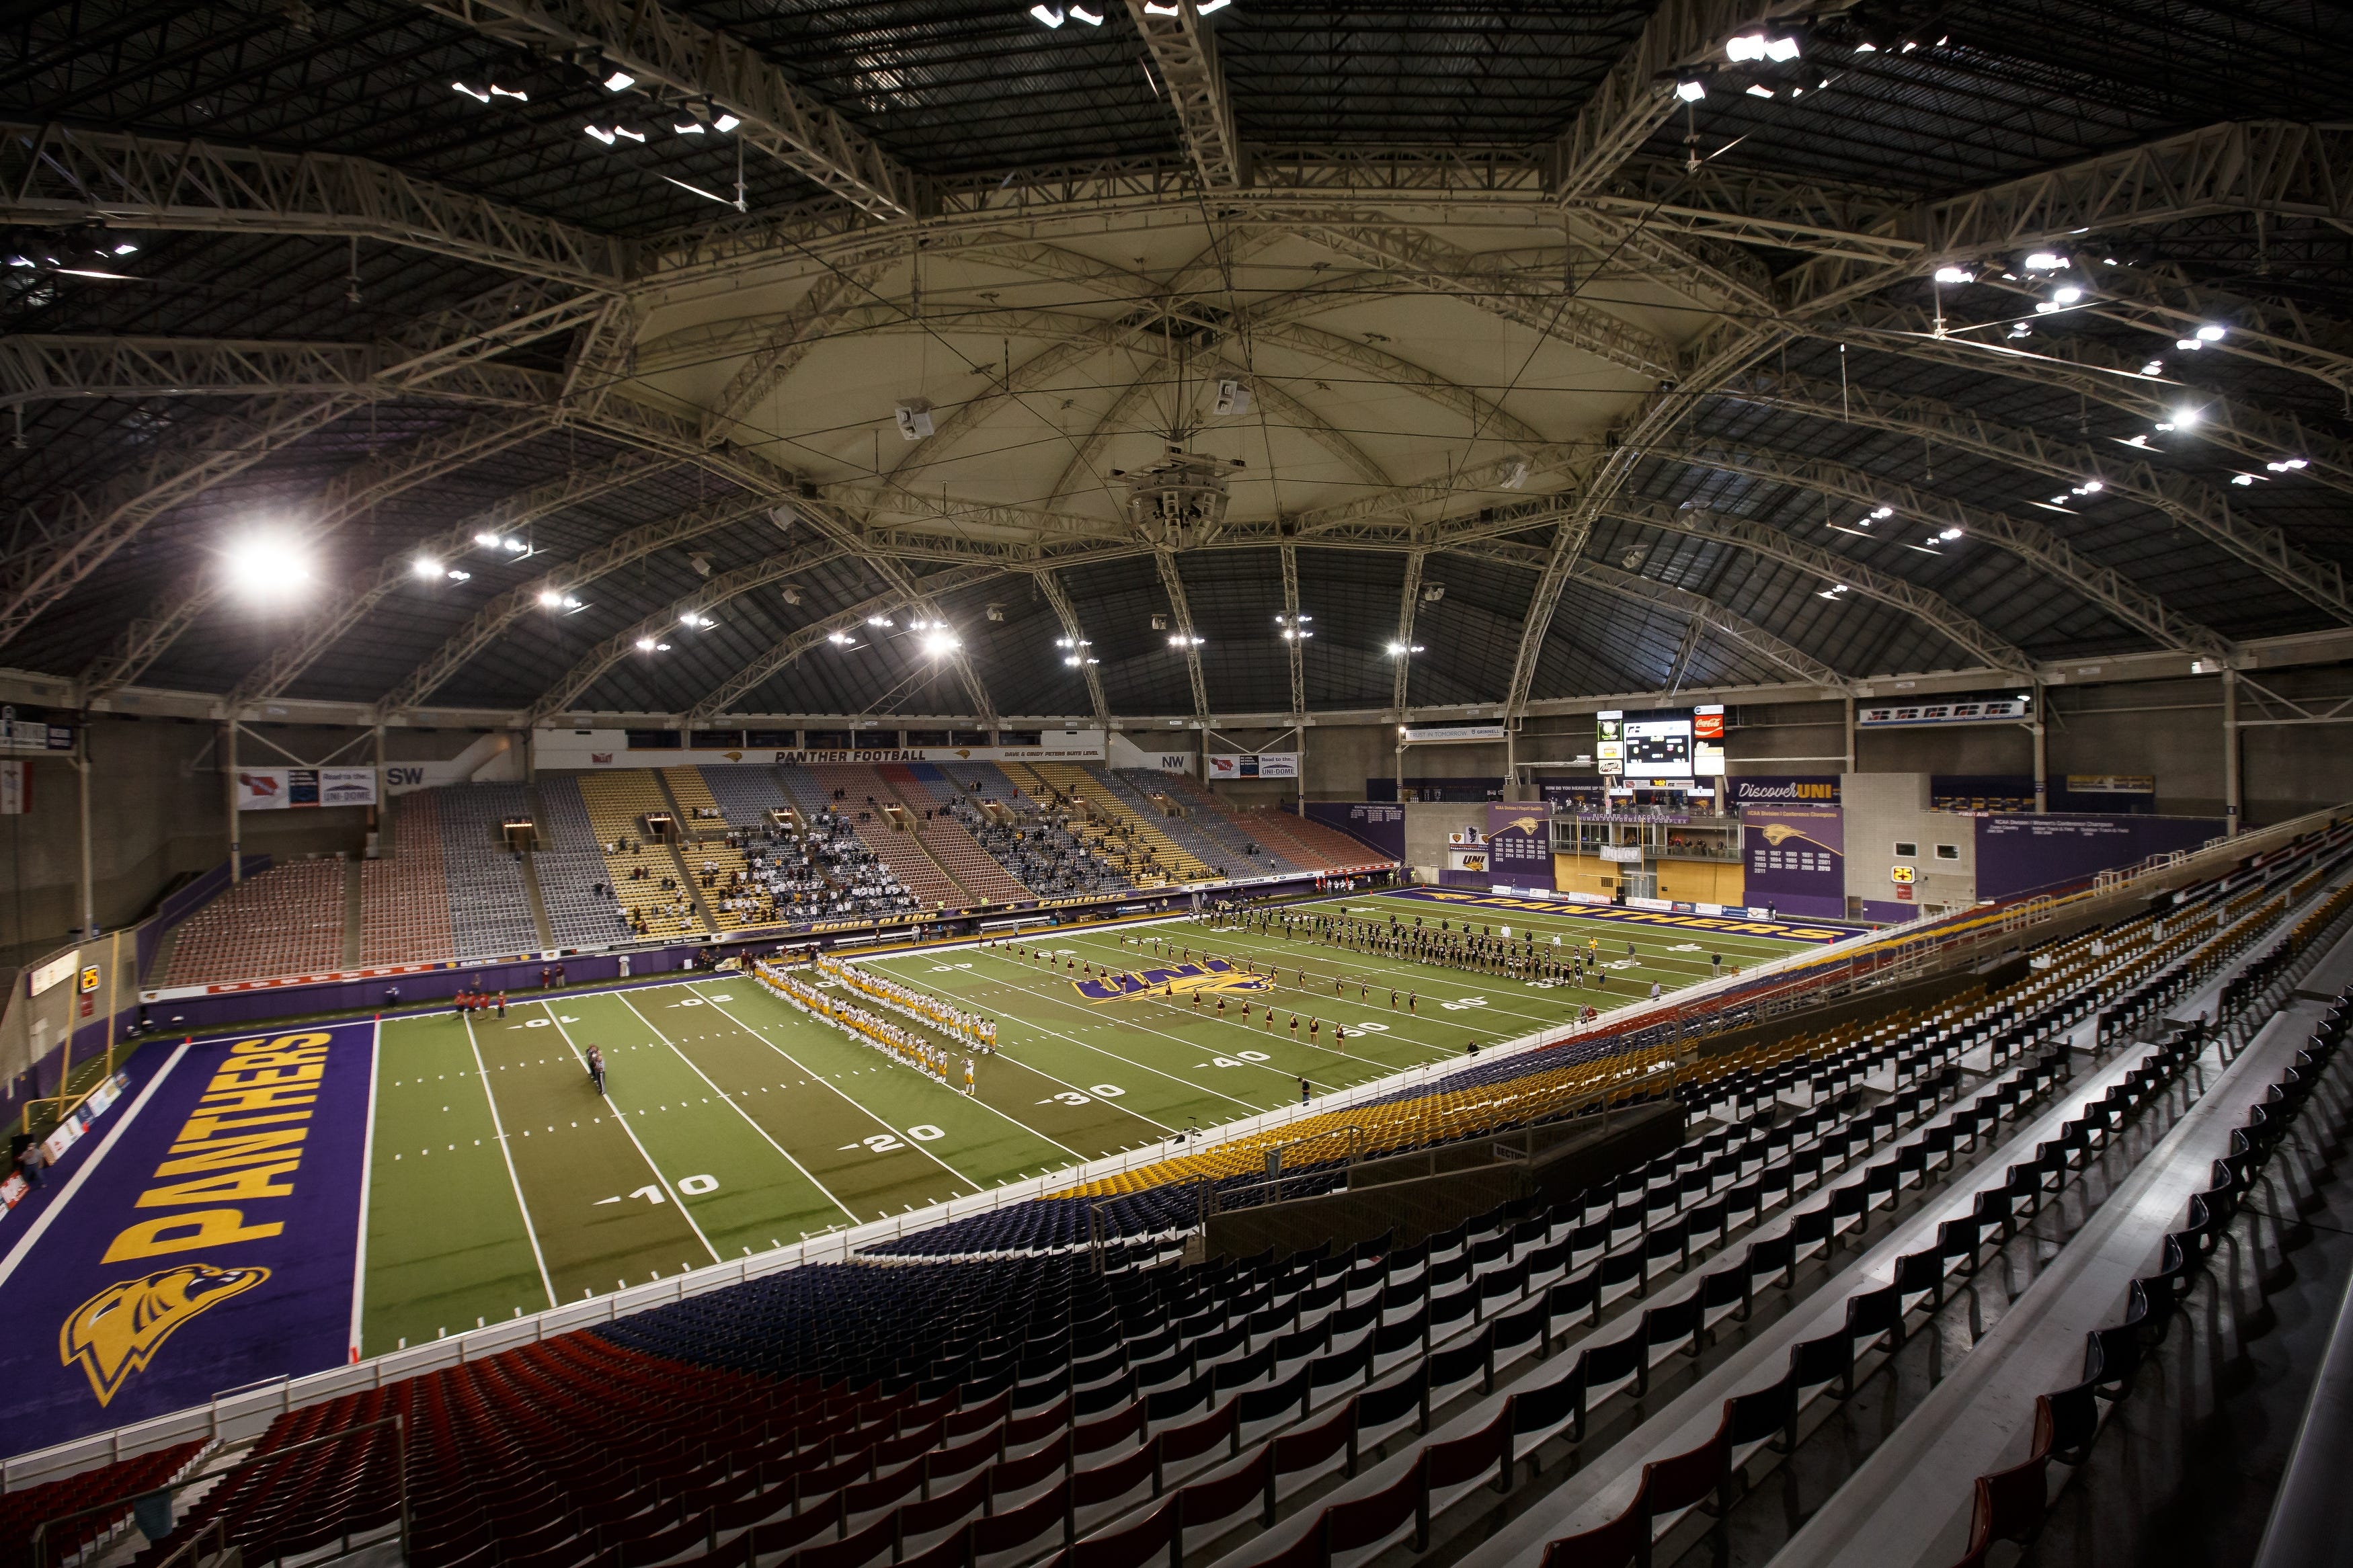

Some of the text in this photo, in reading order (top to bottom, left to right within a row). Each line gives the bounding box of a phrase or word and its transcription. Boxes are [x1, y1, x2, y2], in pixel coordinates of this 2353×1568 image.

[1696, 718, 1721, 727] Coca-Cola
[775, 750, 926, 763] PANTHER FOOTBALL
[1162, 755, 1185, 768] NW
[387, 768, 424, 786] SW
[1739, 782, 1832, 798] Discover UNI
[1463, 855, 1485, 864] UNI
[1894, 868, 1912, 881] 25
[811, 893, 1127, 932] Home of the Panthers
[1467, 898, 1845, 940] PANTHERS
[932, 962, 973, 973] 40
[1071, 959, 1239, 999] UNI
[680, 994, 734, 1007] 20
[1440, 997, 1488, 1010] 40
[525, 1016, 581, 1028] 10
[1332, 1022, 1390, 1038] 50
[1210, 1050, 1271, 1069] 40
[1053, 1083, 1126, 1107] 30
[863, 1124, 946, 1154] 20
[99, 1033, 332, 1264] PANTHERS
[629, 1174, 720, 1205] 10
